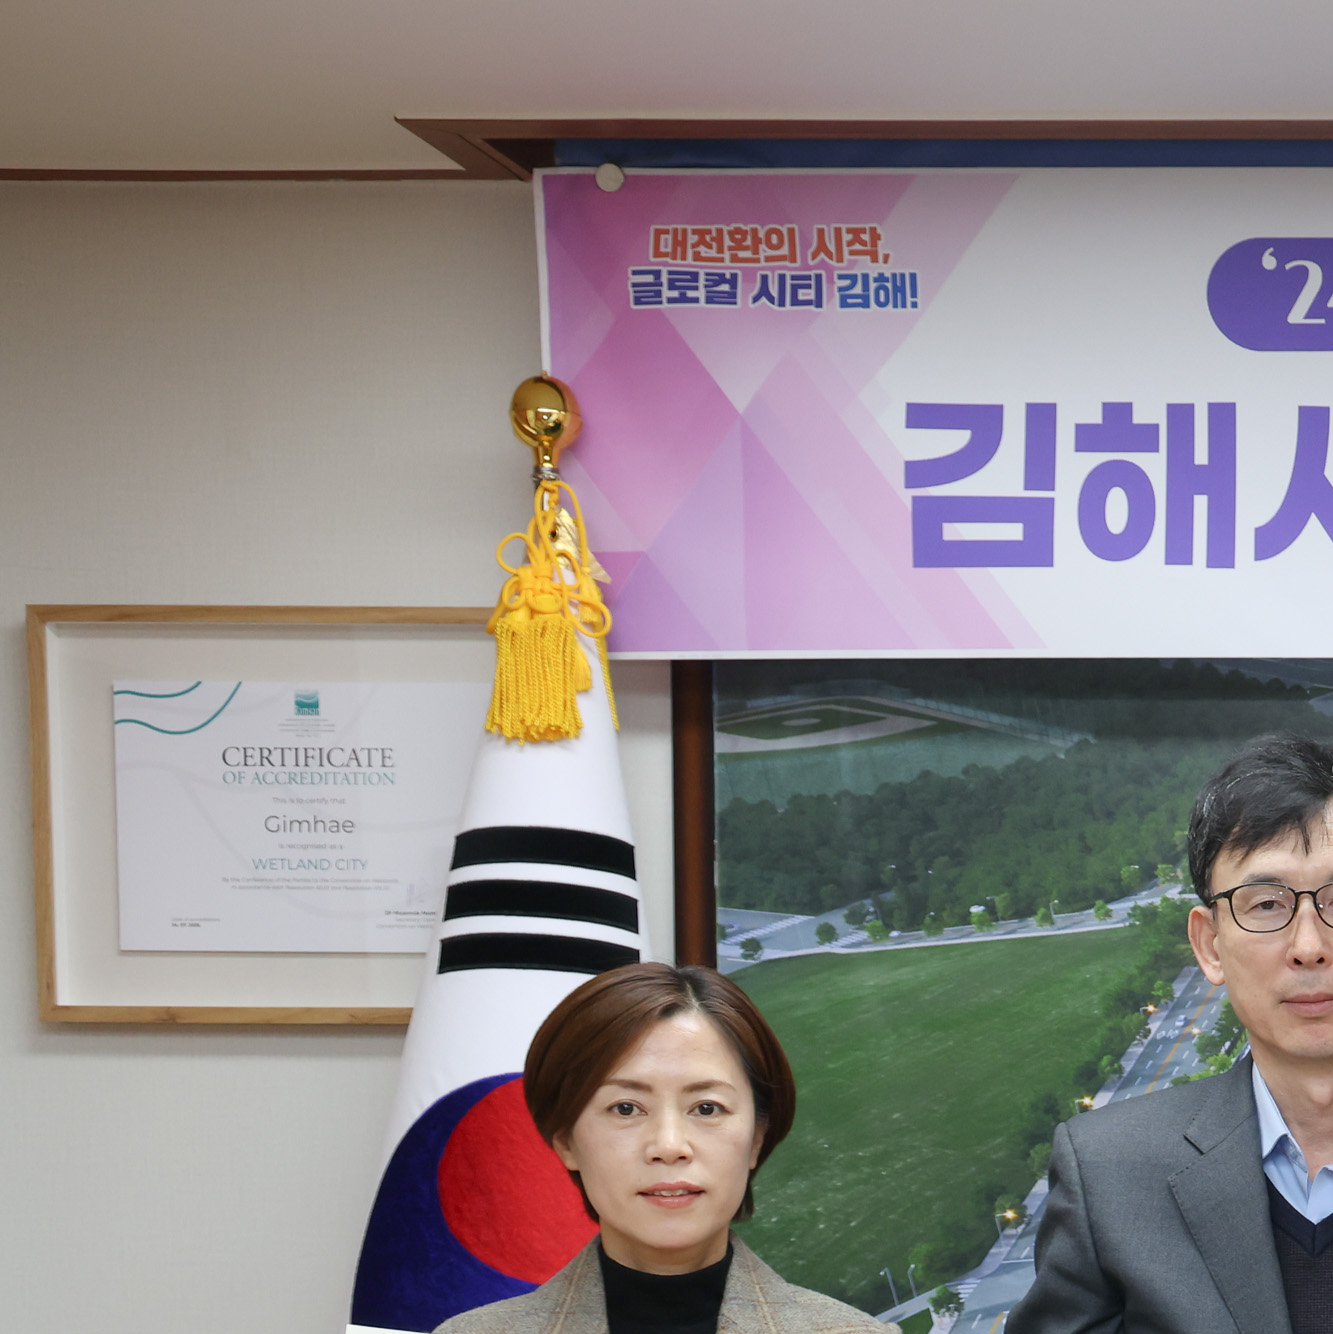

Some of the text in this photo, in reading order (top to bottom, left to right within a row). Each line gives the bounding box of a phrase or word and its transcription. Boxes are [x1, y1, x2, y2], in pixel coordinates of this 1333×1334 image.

[652, 226, 890, 264] 대전환의 시작,
[630, 269, 919, 309] 글로컬 시티 김해!
[222, 746, 395, 768] CERTIFICATE
[222, 771, 396, 786] OF ACCREDITATION
[264, 815, 355, 833] Gimhae
[252, 858, 368, 871] WETLAND CITY
